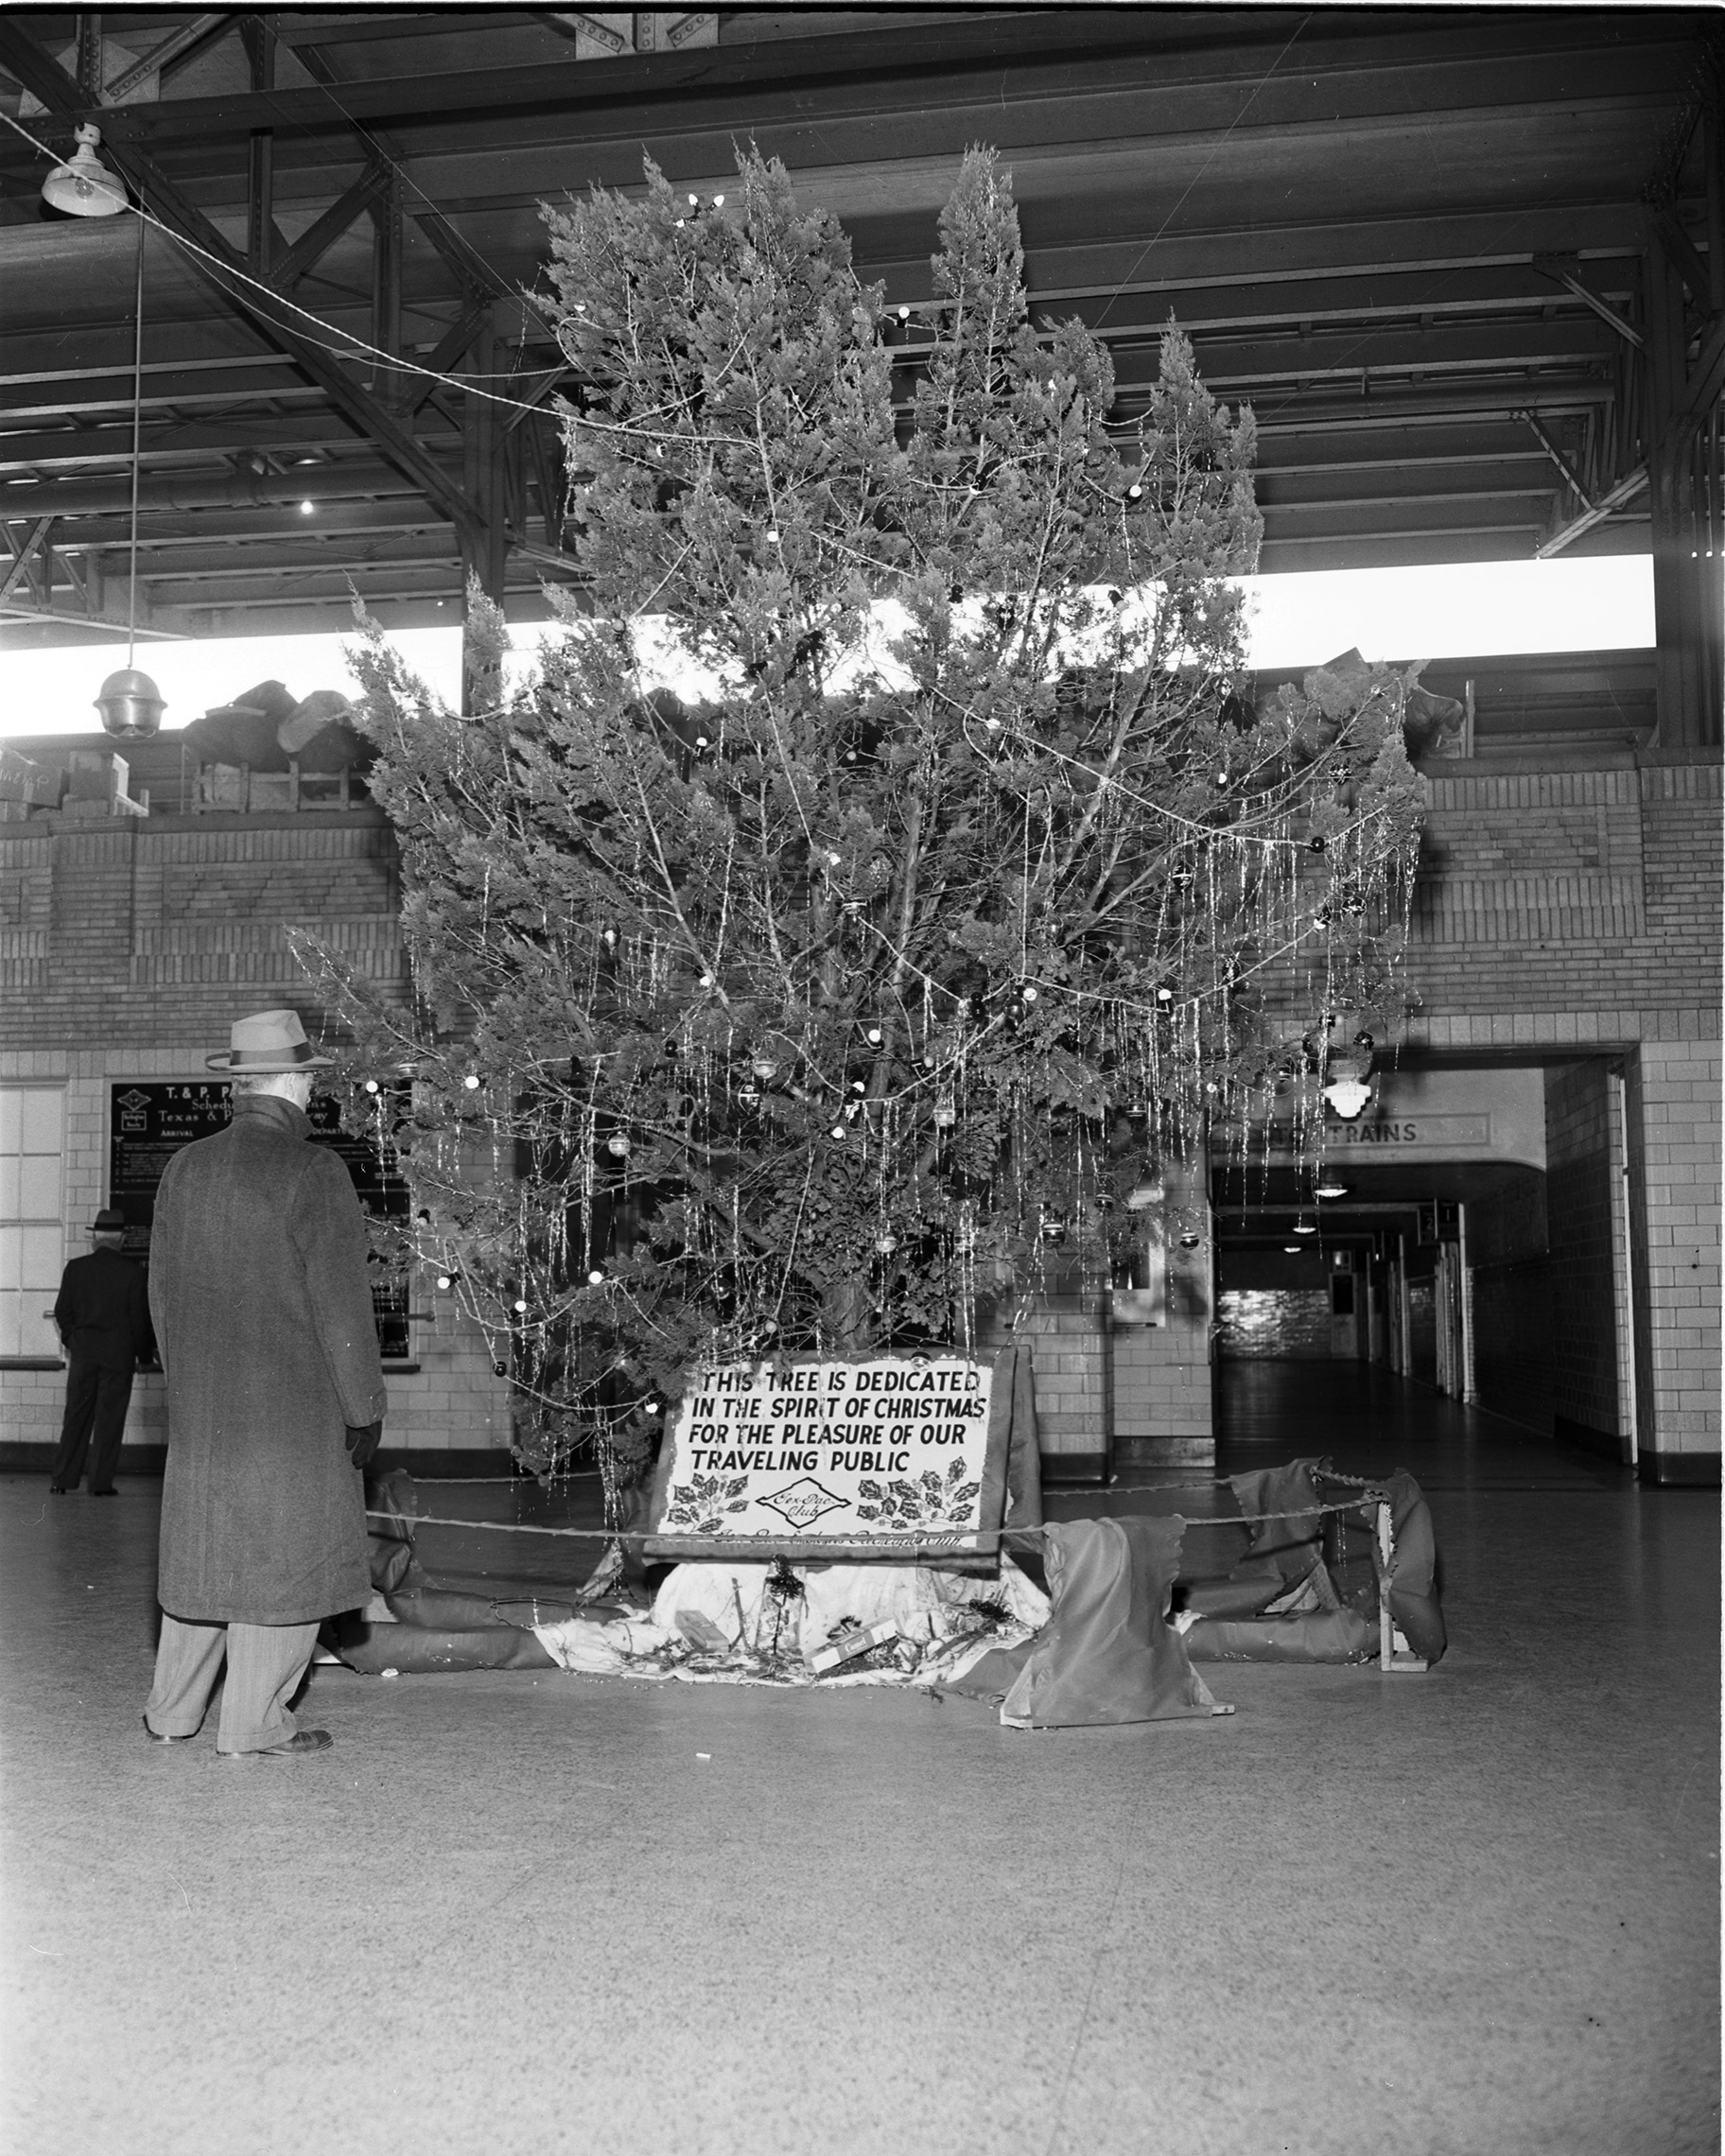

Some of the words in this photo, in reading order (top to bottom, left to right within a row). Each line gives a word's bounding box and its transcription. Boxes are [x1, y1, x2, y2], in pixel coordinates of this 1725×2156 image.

[182, 1087, 191, 1099] &
[158, 1110, 199, 1121] Texas
[206, 1110, 217, 1121] &
[1328, 1123, 1416, 1143] TRAINS
[703, 1371, 753, 1391] THIS
[766, 1371, 819, 1391] TREE
[828, 1371, 845, 1390] IS
[855, 1371, 981, 1391] DEDICATED
[692, 1398, 715, 1417] IN
[723, 1398, 760, 1417] THE
[845, 1398, 869, 1417] OF
[874, 1398, 985, 1417] CHRISTMAS
[688, 1424, 728, 1443] FOR
[737, 1424, 775, 1444] THE
[781, 1424, 881, 1444] PLEASURE
[889, 1424, 913, 1444] OF
[920, 1424, 966, 1444] OUR
[690, 1451, 818, 1470] TRAVELING
[830, 1451, 909, 1471] PUBLIC
[788, 1504, 819, 1518] Club
